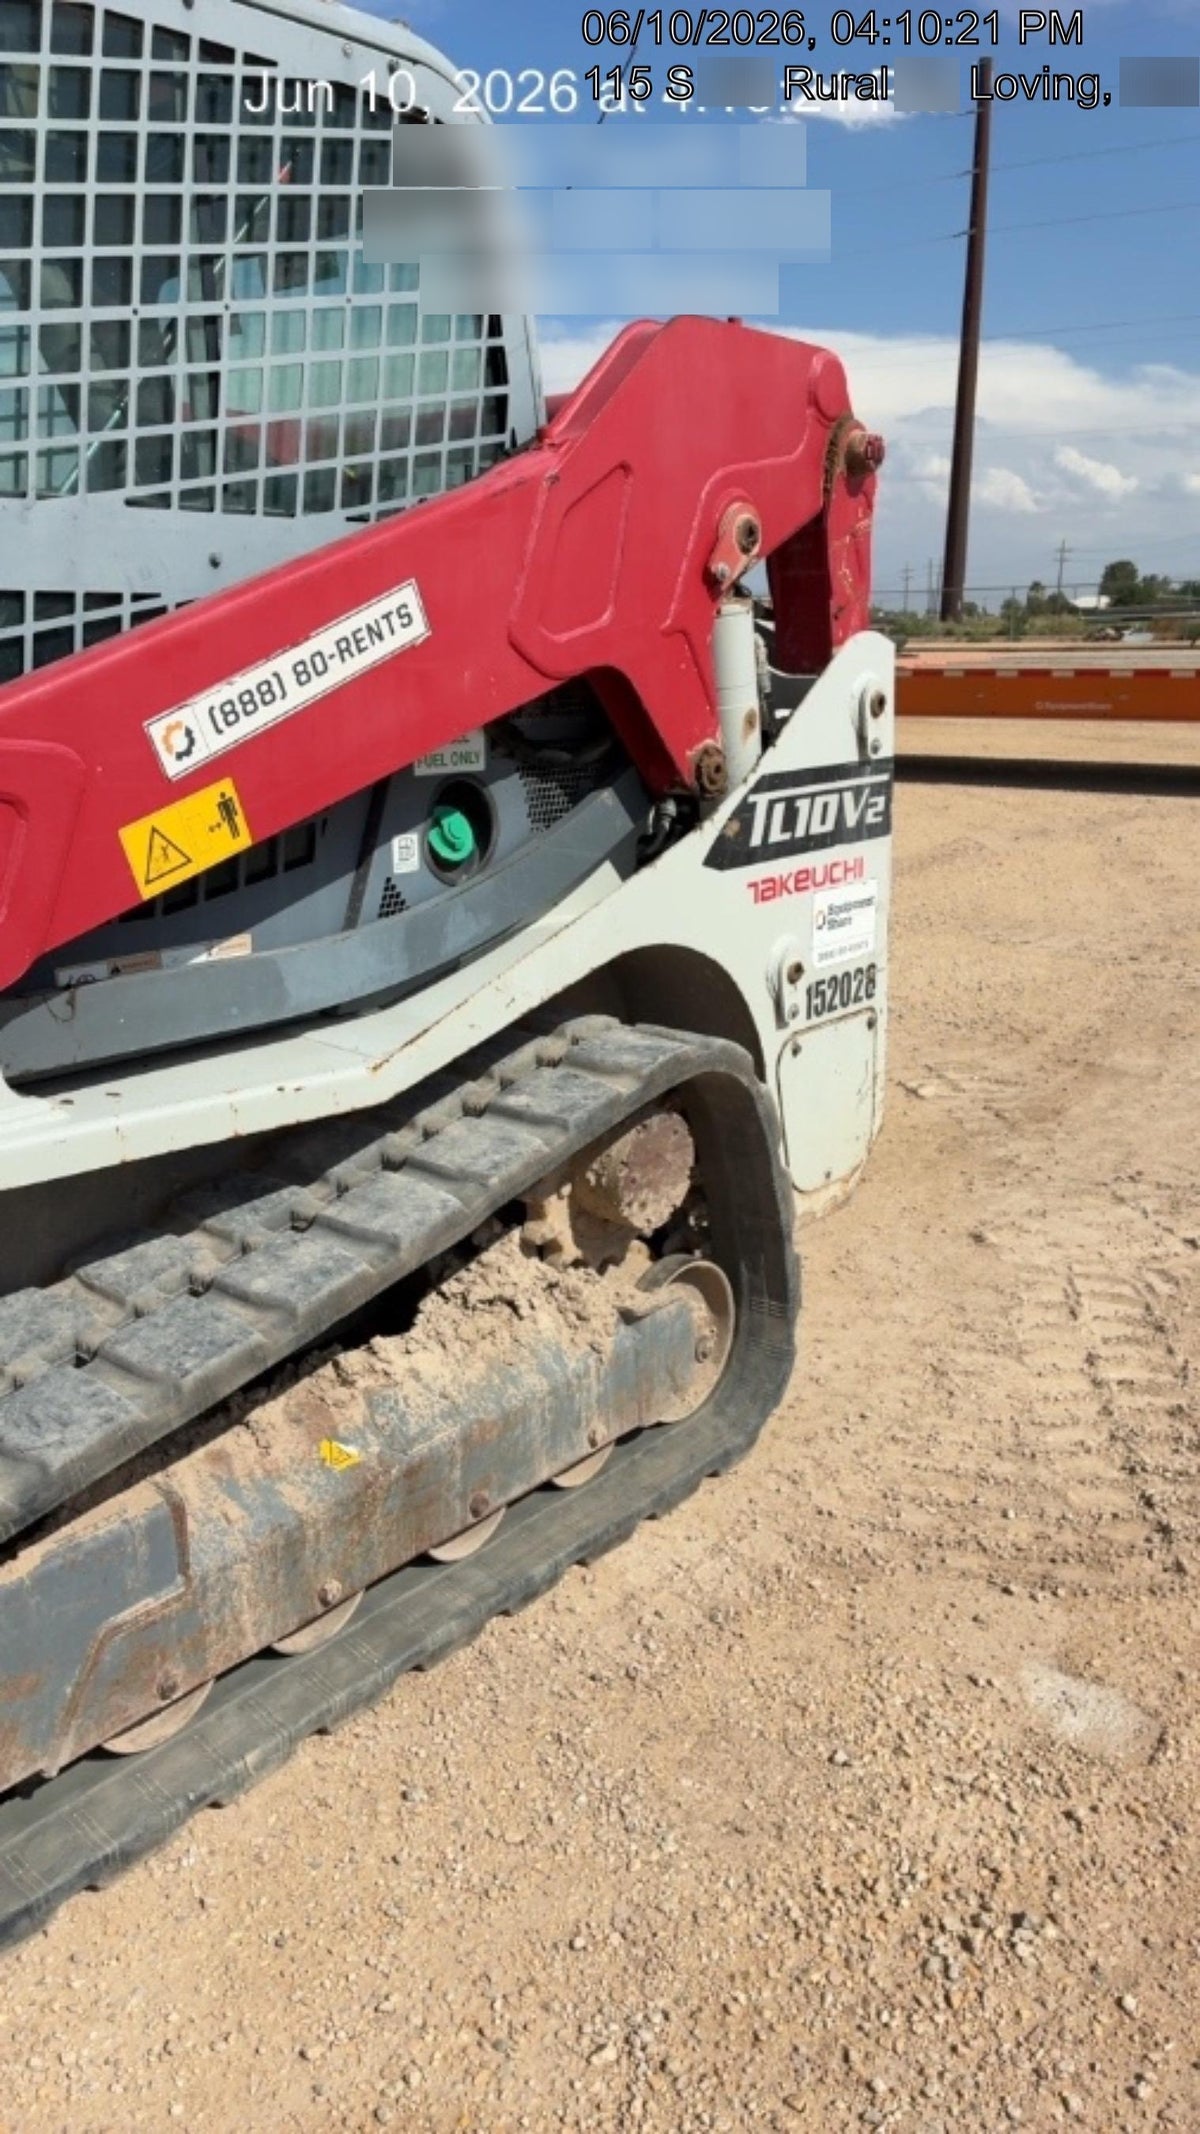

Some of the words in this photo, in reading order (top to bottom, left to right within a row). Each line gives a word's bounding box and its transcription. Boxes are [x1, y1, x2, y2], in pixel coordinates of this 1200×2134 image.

[207, 672, 289, 735] (888)
[291, 603, 415, 687] 80-RENTS
[450, 750, 481, 767] ONLY
[805, 962, 877, 1021] 152028
